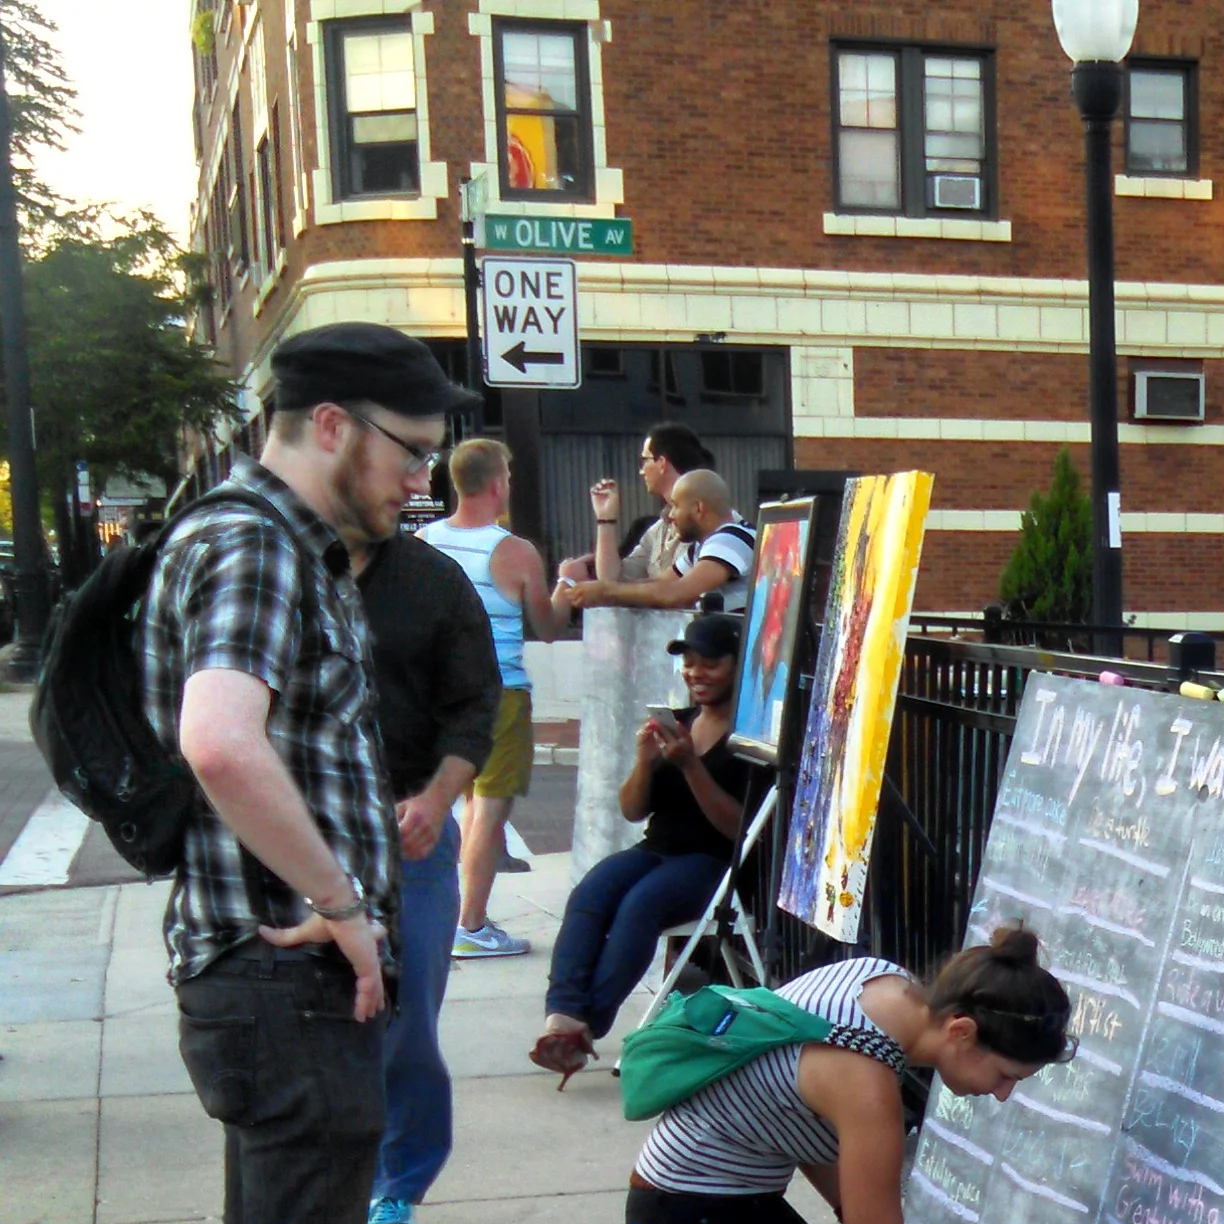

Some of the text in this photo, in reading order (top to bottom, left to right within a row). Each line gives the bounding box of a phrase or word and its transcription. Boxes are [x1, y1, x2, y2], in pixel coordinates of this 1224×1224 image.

[494, 219, 625, 249] W OLIVE AV
[494, 270, 565, 300] ONE
[493, 305, 566, 334] WAY
[1021, 688, 1066, 769] In
[1065, 706, 1104, 807] my
